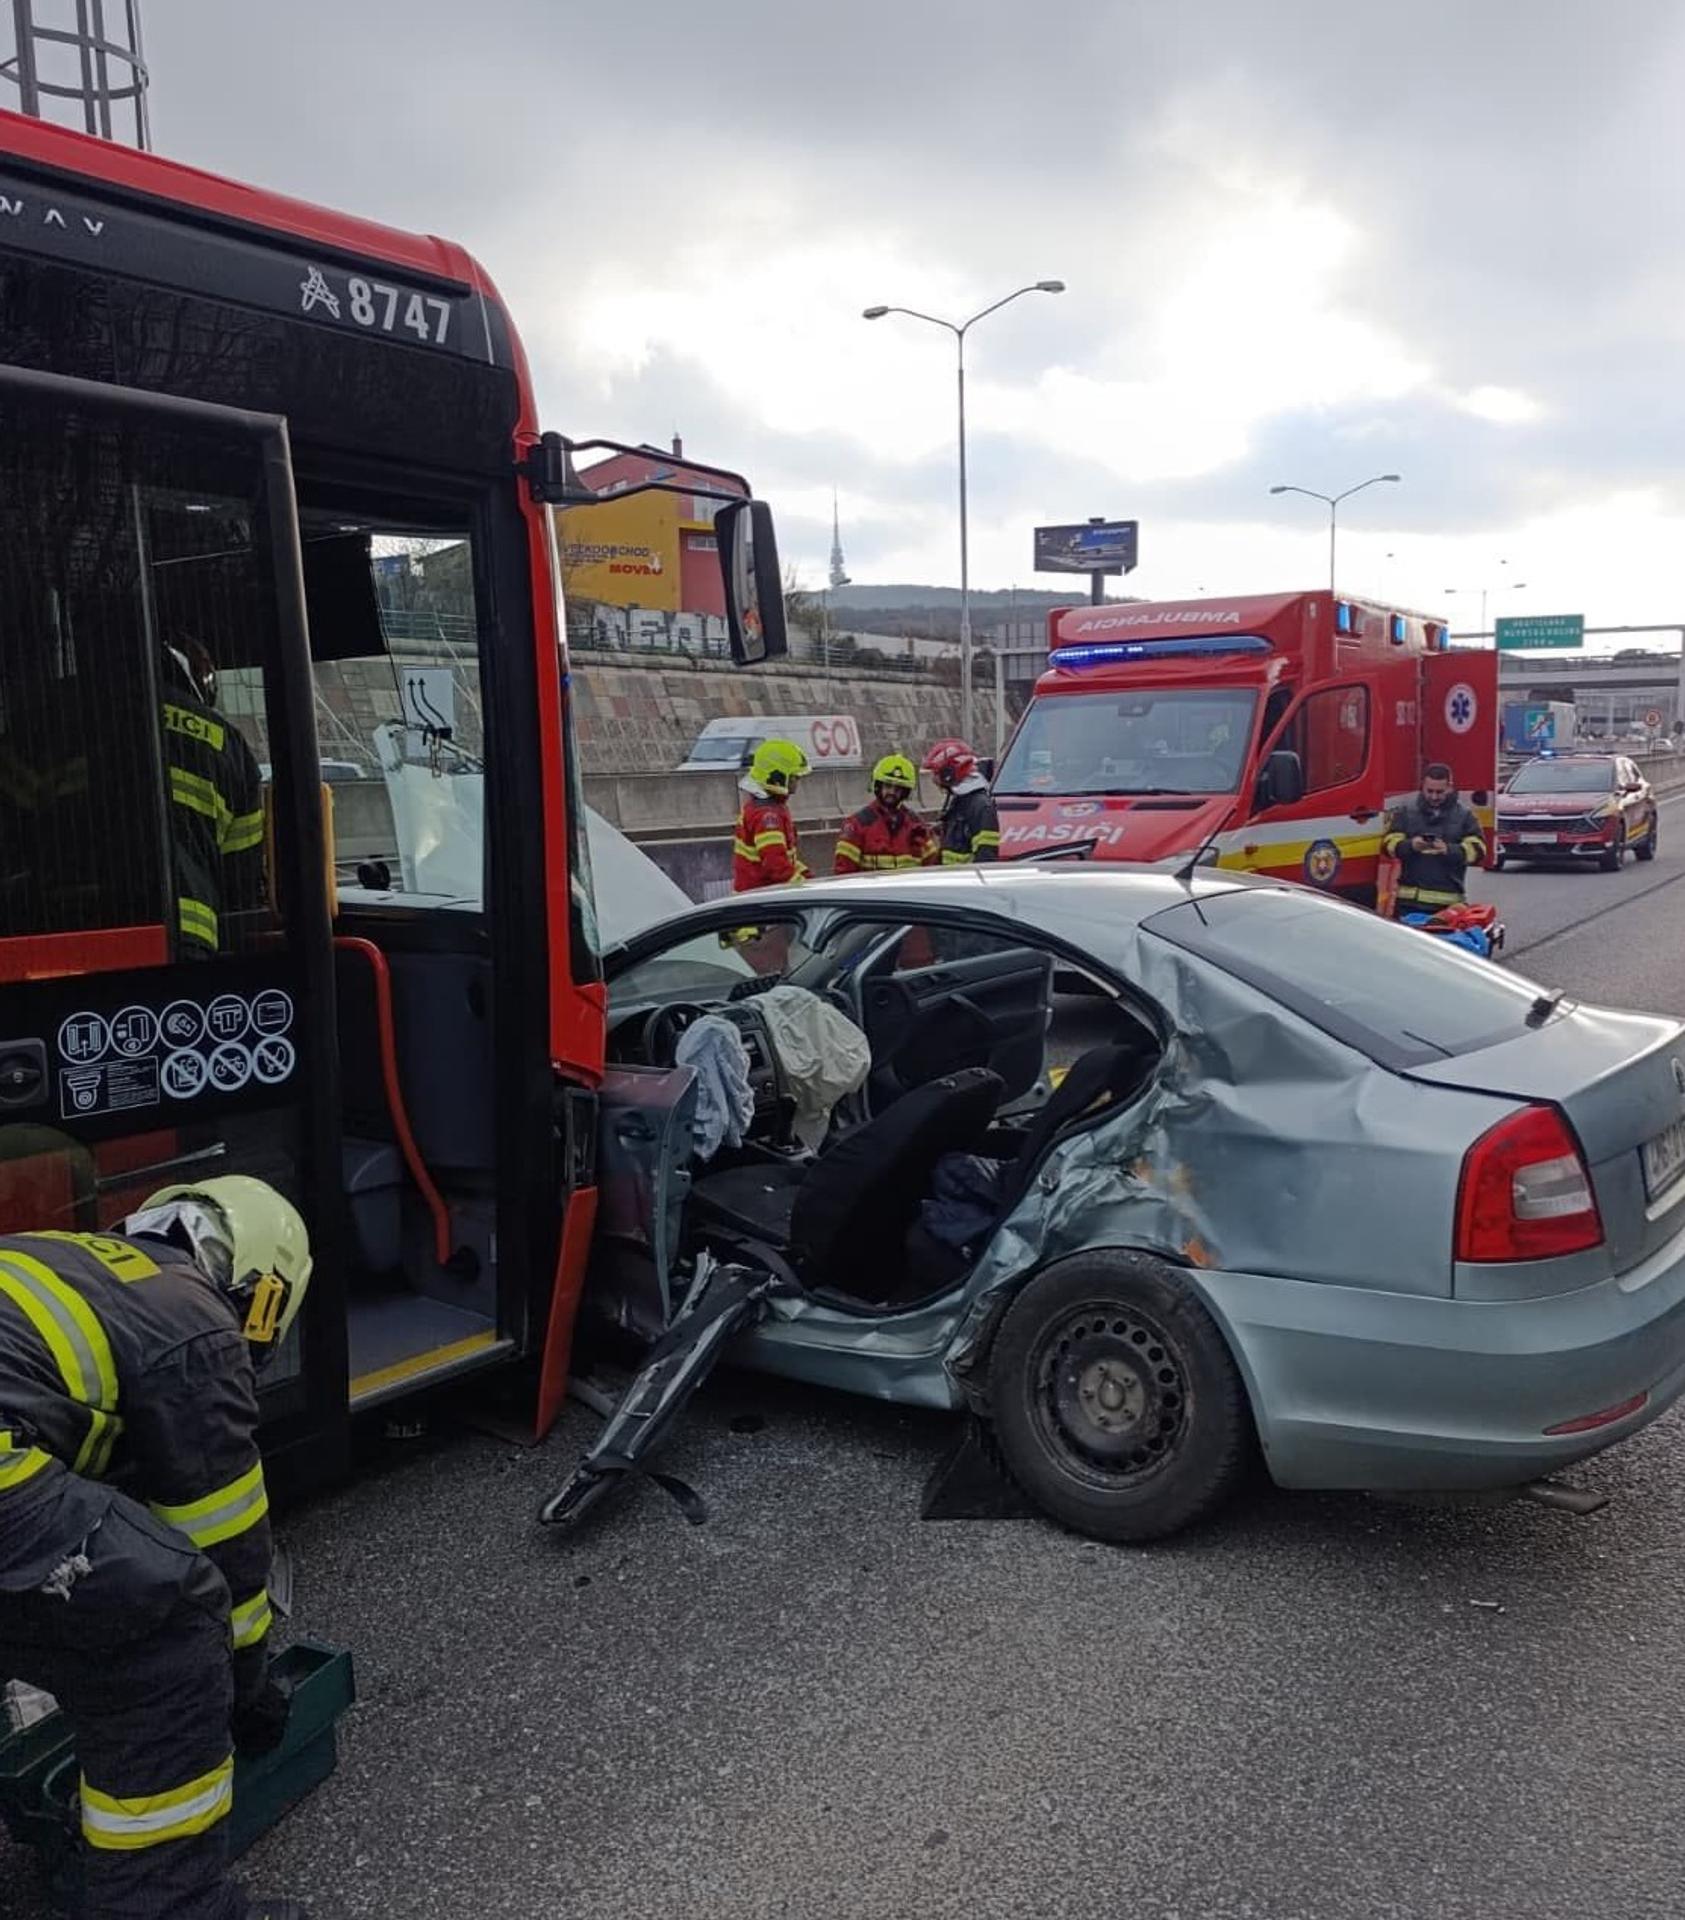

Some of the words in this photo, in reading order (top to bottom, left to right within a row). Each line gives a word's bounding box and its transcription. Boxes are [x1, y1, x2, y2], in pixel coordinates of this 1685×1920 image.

[348, 277, 450, 344] 8747
[811, 720, 858, 757] GO!
[1000, 821, 1125, 844] HASIČI
